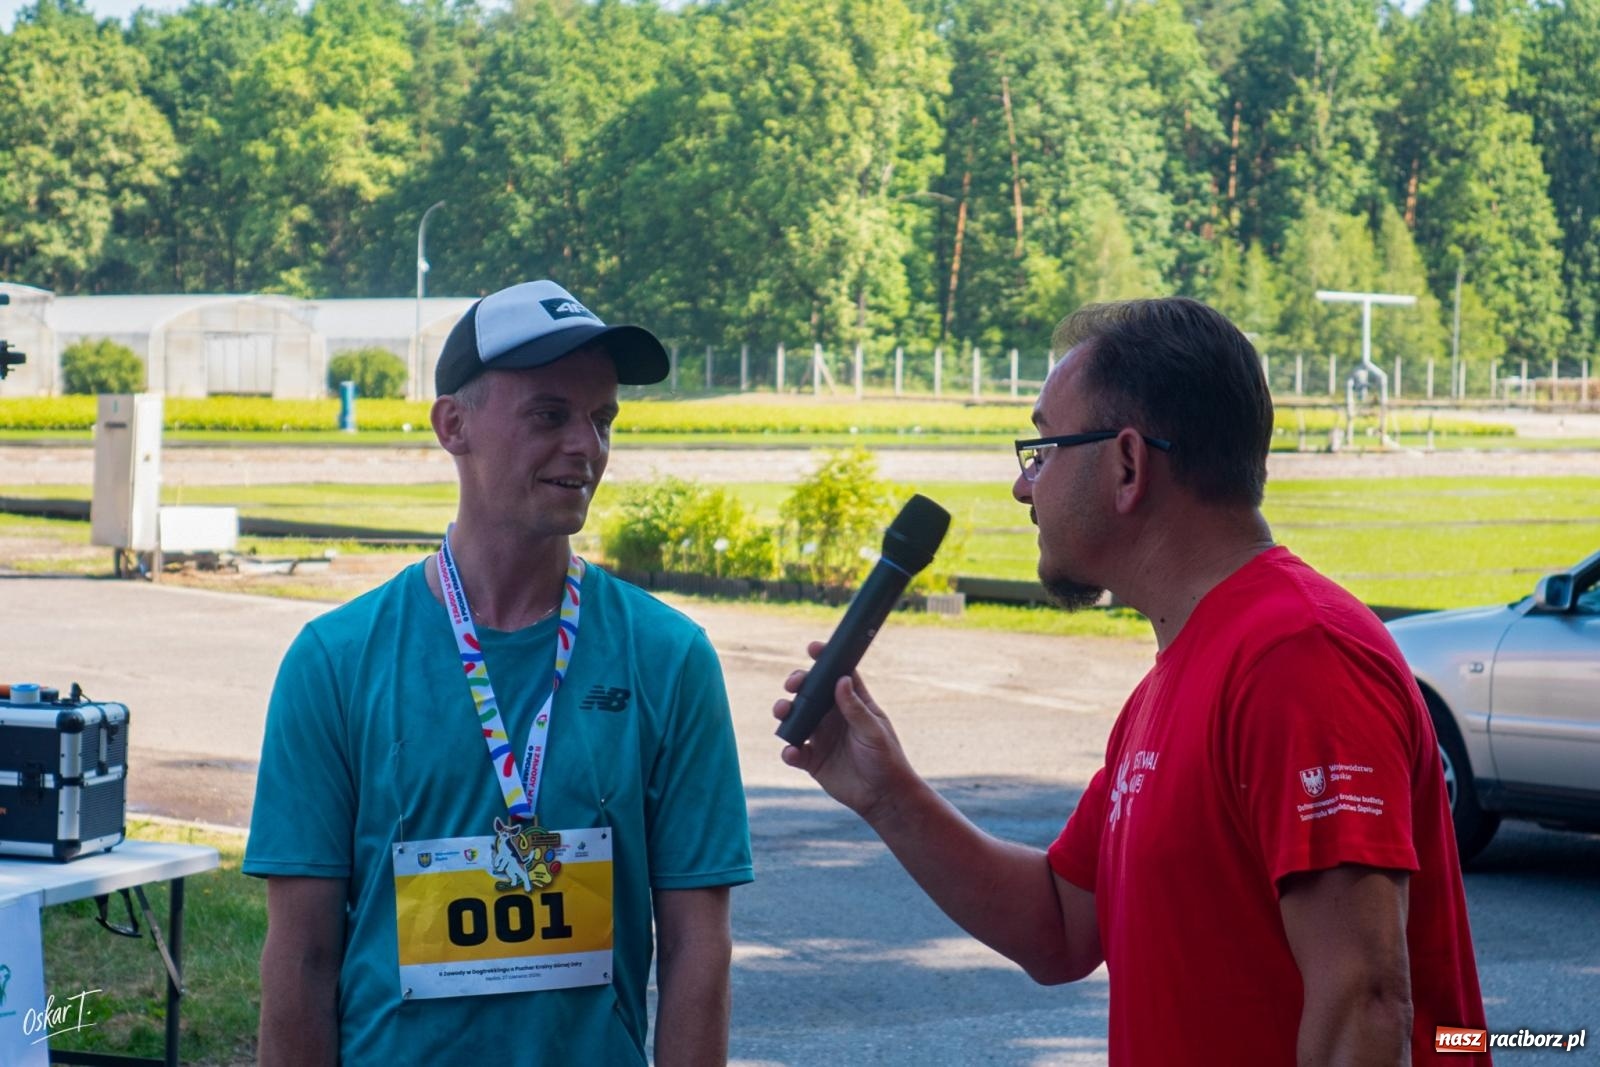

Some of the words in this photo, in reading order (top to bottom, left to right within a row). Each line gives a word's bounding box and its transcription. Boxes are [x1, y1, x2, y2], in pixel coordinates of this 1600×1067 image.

[529, 752, 540, 787] ZAWODY
[447, 892, 573, 946] 001
[443, 970, 465, 978] Zawody
